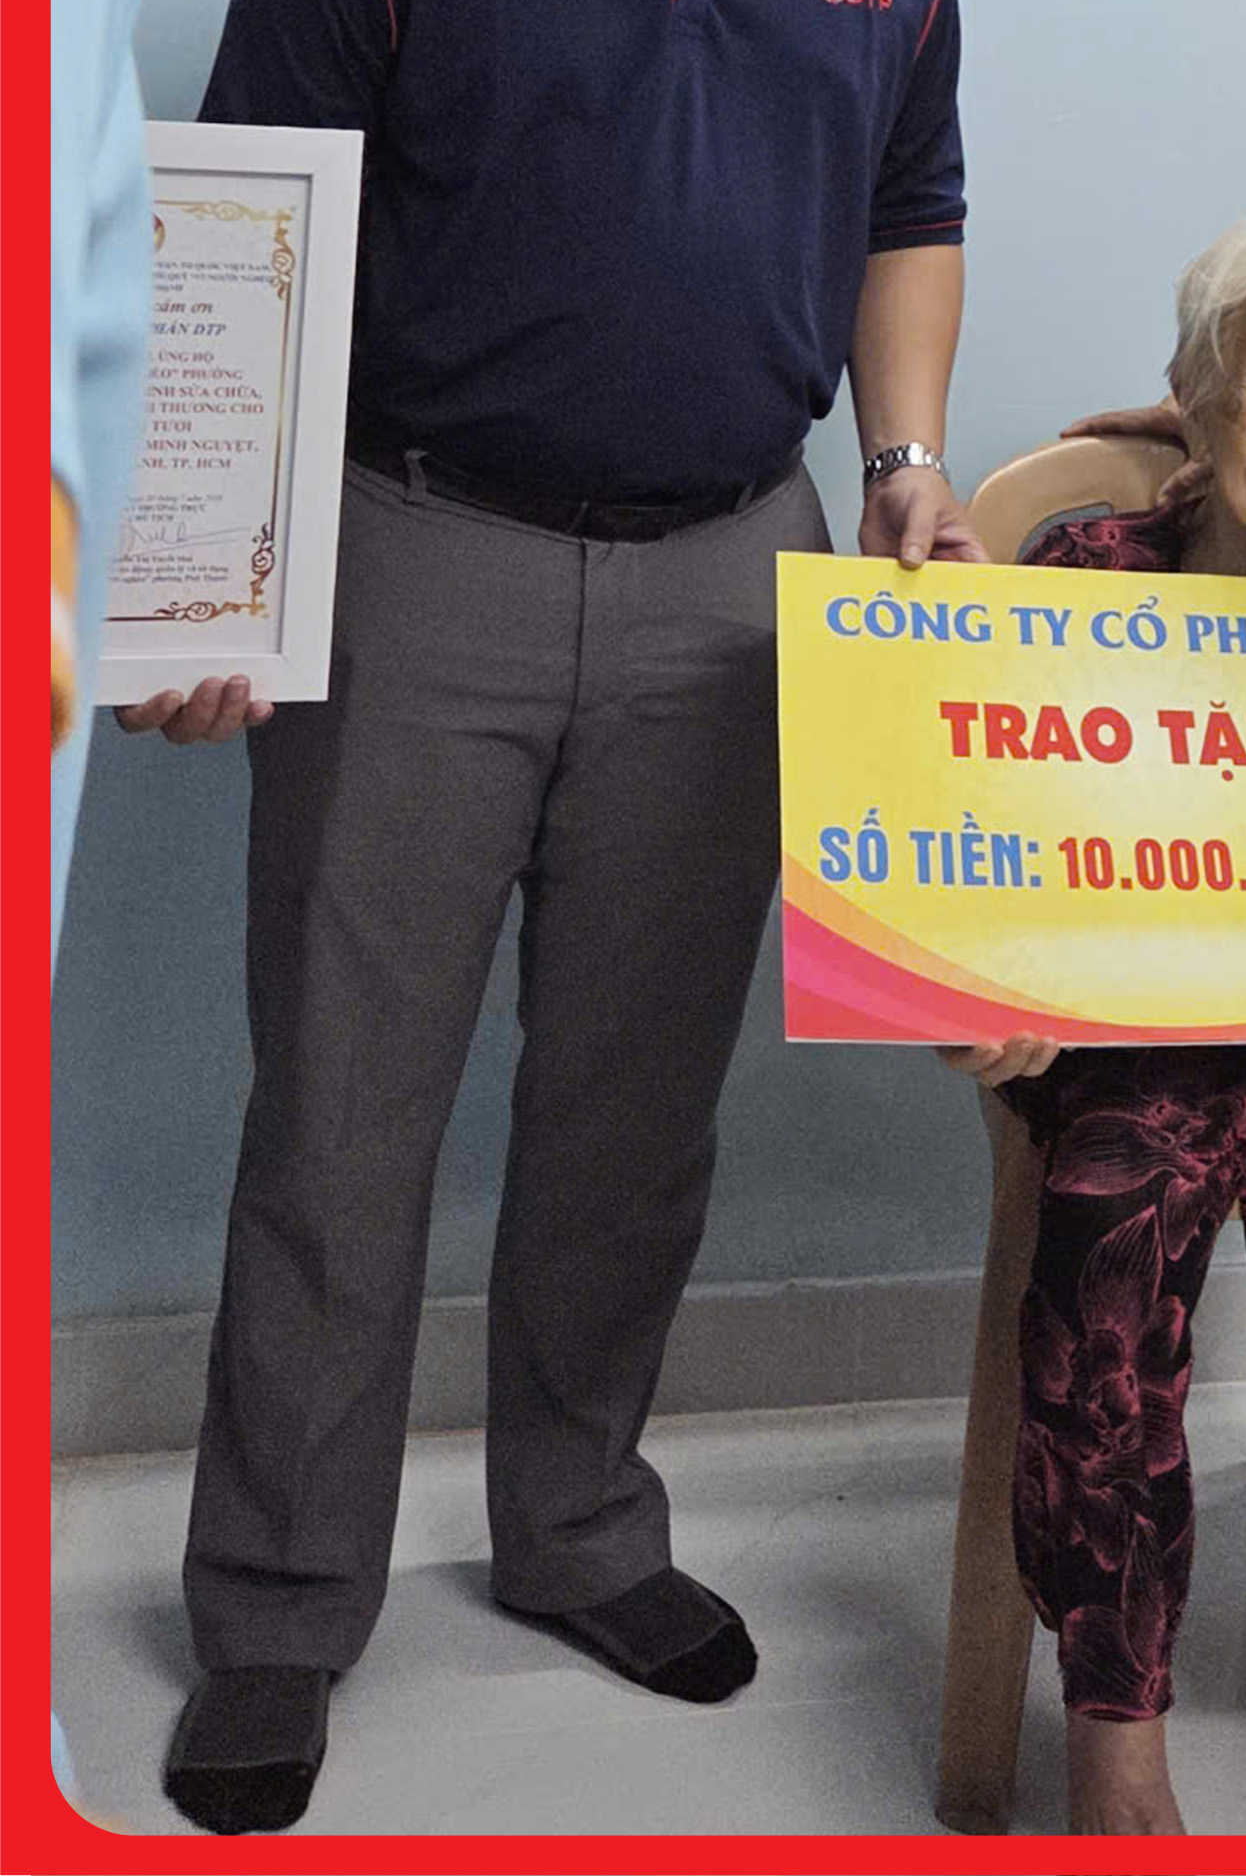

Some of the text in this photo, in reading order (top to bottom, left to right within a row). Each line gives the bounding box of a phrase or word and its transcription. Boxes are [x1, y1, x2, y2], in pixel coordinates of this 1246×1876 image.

[193, 323, 227, 336] DTP
[825, 590, 993, 643] CÔNG
[1009, 605, 1074, 647] TY
[1090, 596, 1169, 652] CỔ
[939, 699, 1134, 765] TRAO
[819, 808, 891, 884] SỐ
[908, 810, 1042, 889] TIỀN:
